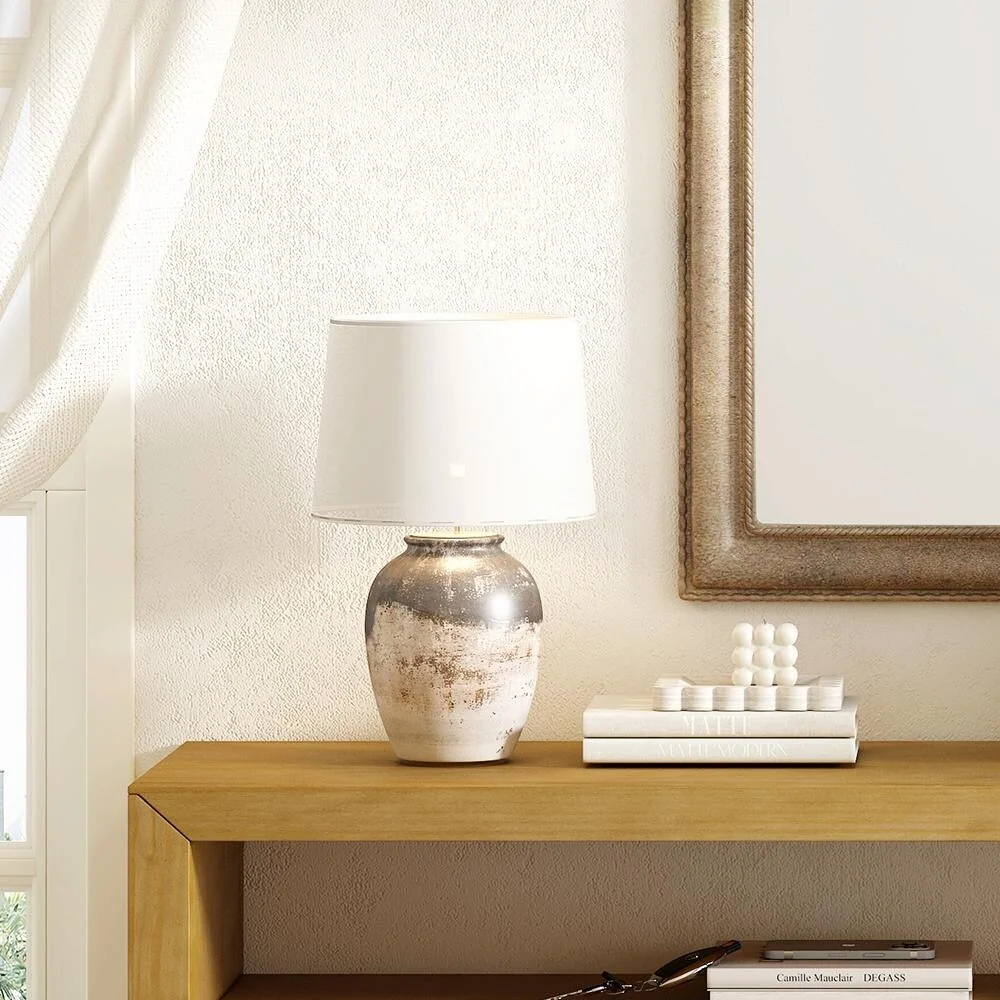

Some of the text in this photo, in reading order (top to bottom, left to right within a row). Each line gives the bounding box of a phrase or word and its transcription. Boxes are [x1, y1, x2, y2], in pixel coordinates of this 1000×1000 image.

[776, 972, 906, 983] Camille Mauclair DEGASS
